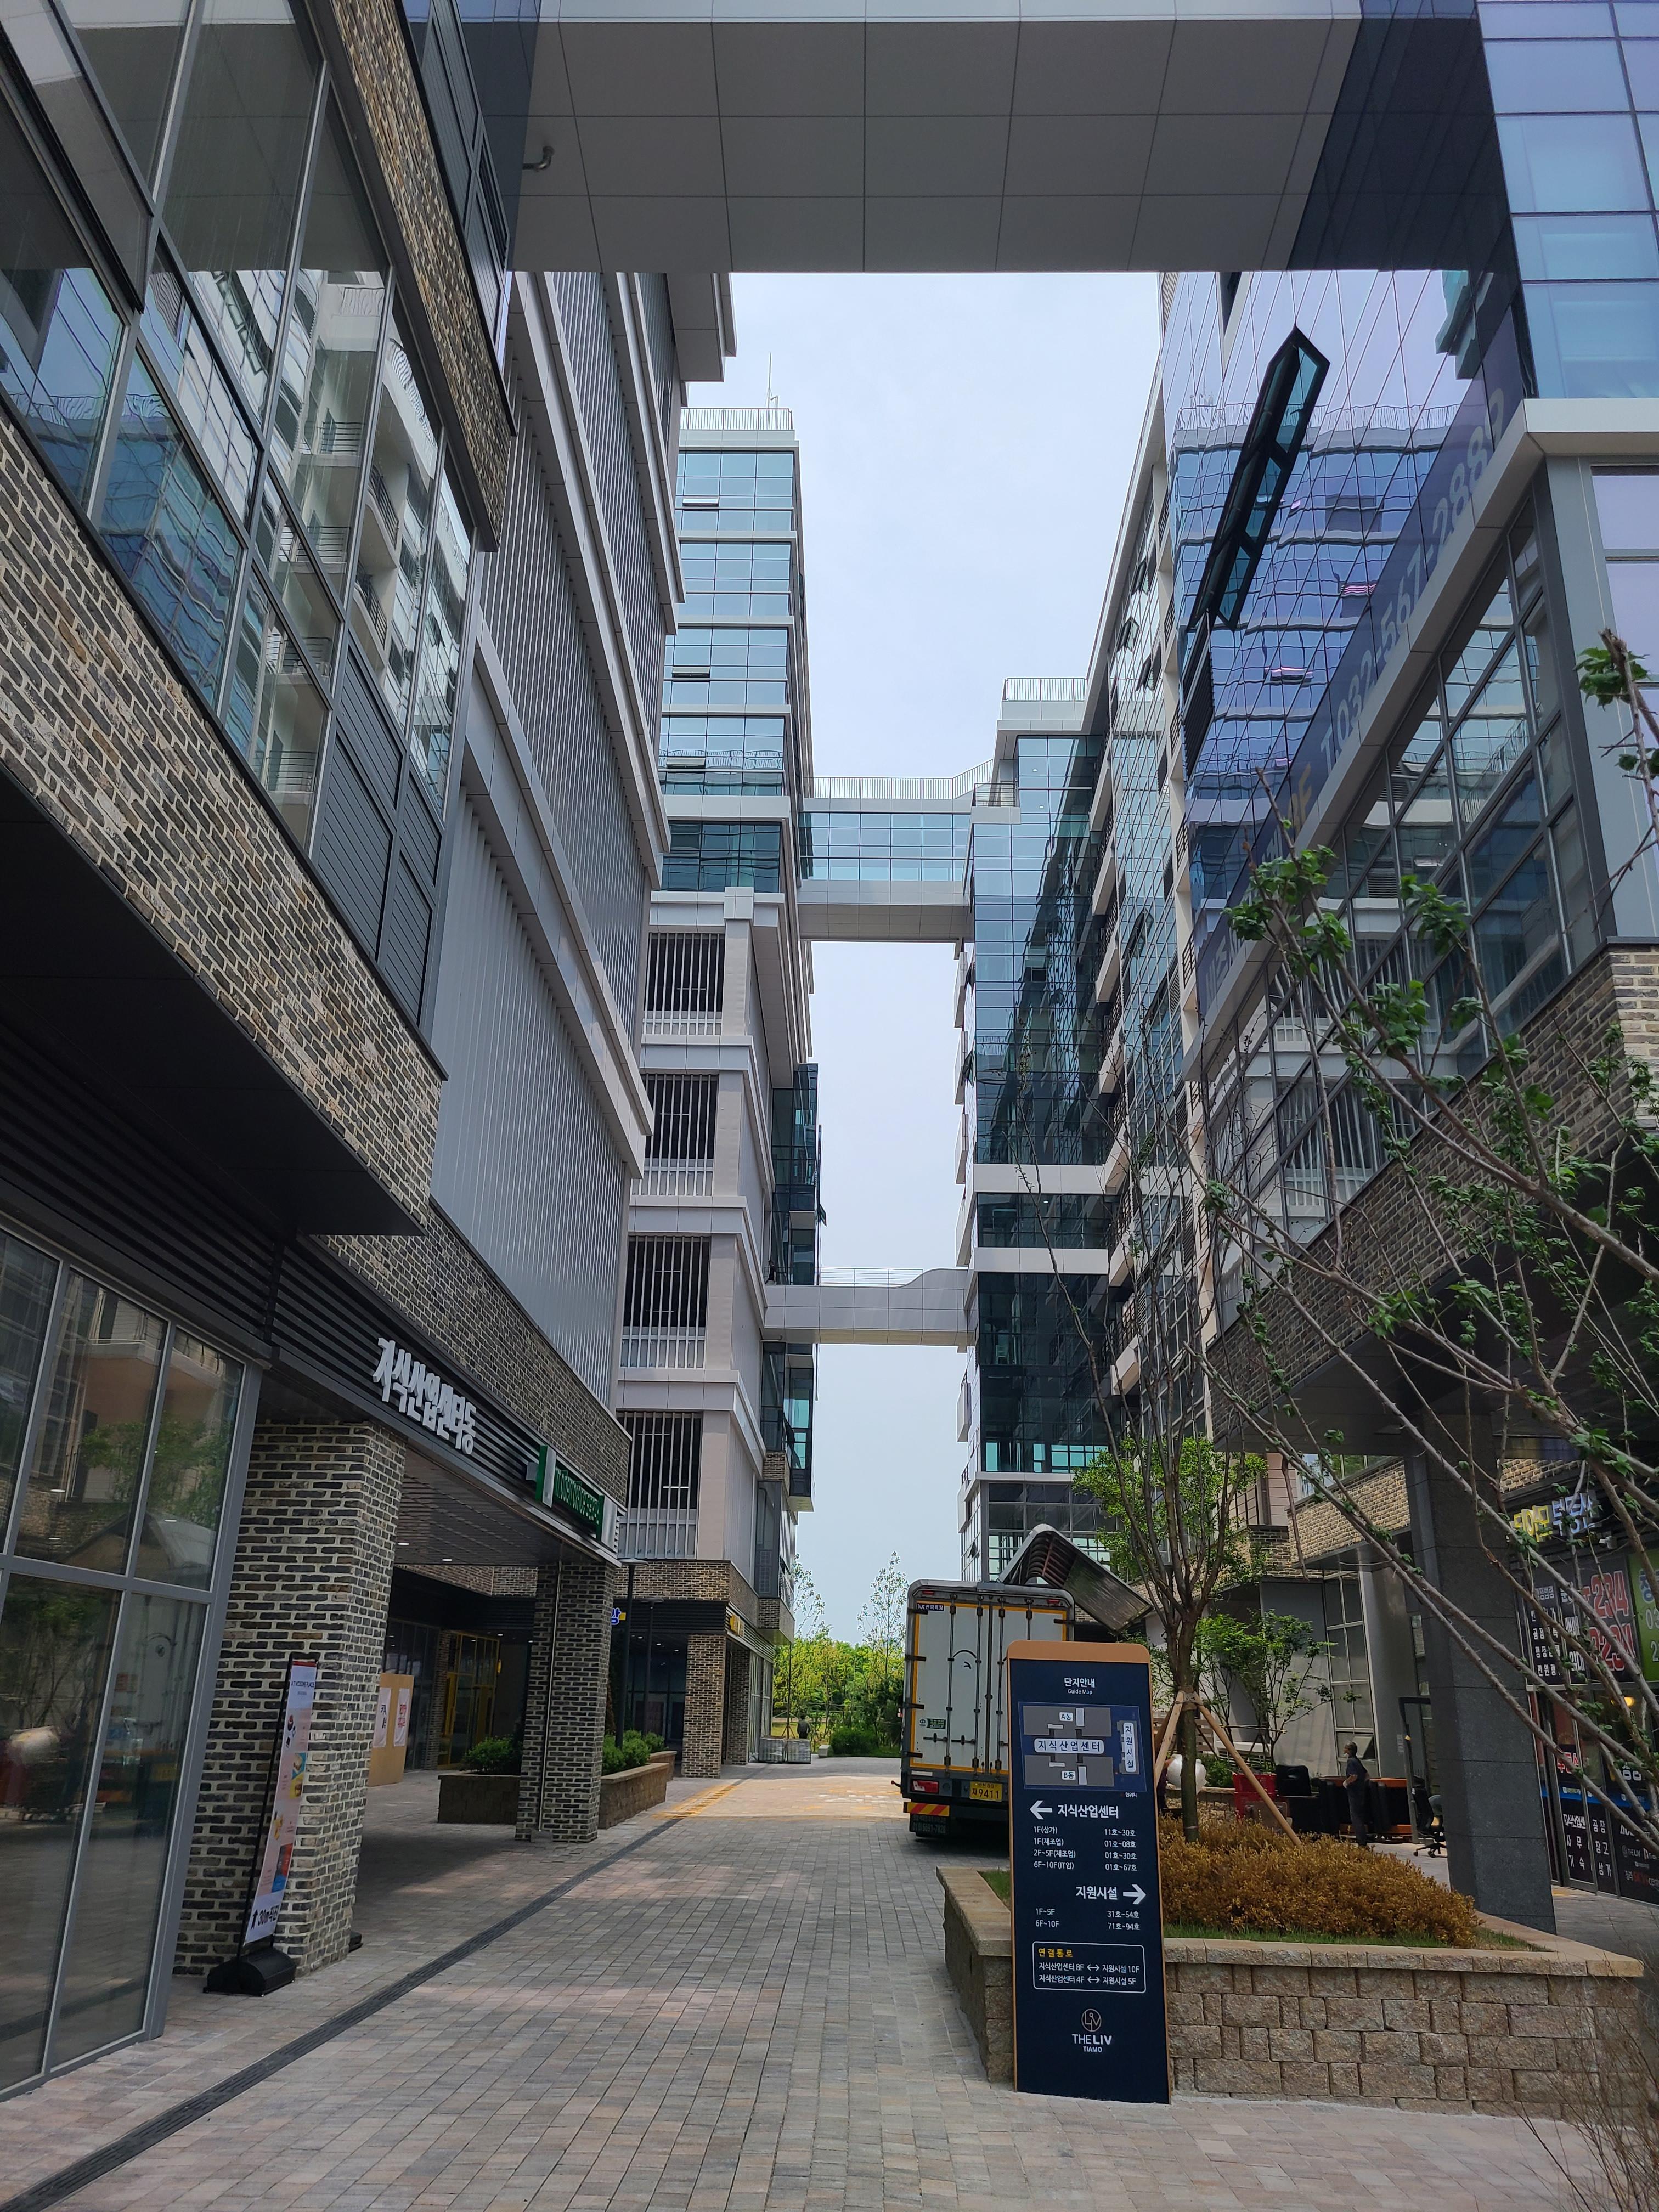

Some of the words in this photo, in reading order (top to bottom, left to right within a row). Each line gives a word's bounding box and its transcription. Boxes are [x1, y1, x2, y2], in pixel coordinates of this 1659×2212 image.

[1064, 1678, 1096, 1688] 단지안내
[1038, 1741, 1101, 1752] 지식산업센터
[1125, 1726, 1134, 1769] 지원시설
[1057, 1804, 1119, 1819] 지식산업센터
[1034, 1826, 1058, 1835] 1F(상가)
[1034, 1838, 1064, 1846] 1F(제조업)
[1104, 1840, 1137, 1848] 01호~08호
[1034, 1849, 1076, 1858] 2F~5F(제조업)
[1104, 1852, 1137, 1860] 01호~30호
[1034, 1861, 1074, 1870] 6F~10F(IT업)
[1076, 1886, 1118, 1900] 지원시설
[1107, 1910, 1139, 1918] 31호~54호
[1108, 1922, 1140, 1931] 71호~94호
[1038, 1948, 1073, 1958] 연결통로
[1039, 1962, 1075, 1971] 지식산업센터
[1102, 1965, 1126, 1973] 지원시설
[1039, 1974, 1075, 1983] 지식산업센터
[1102, 1977, 1127, 1985] 지원시설
